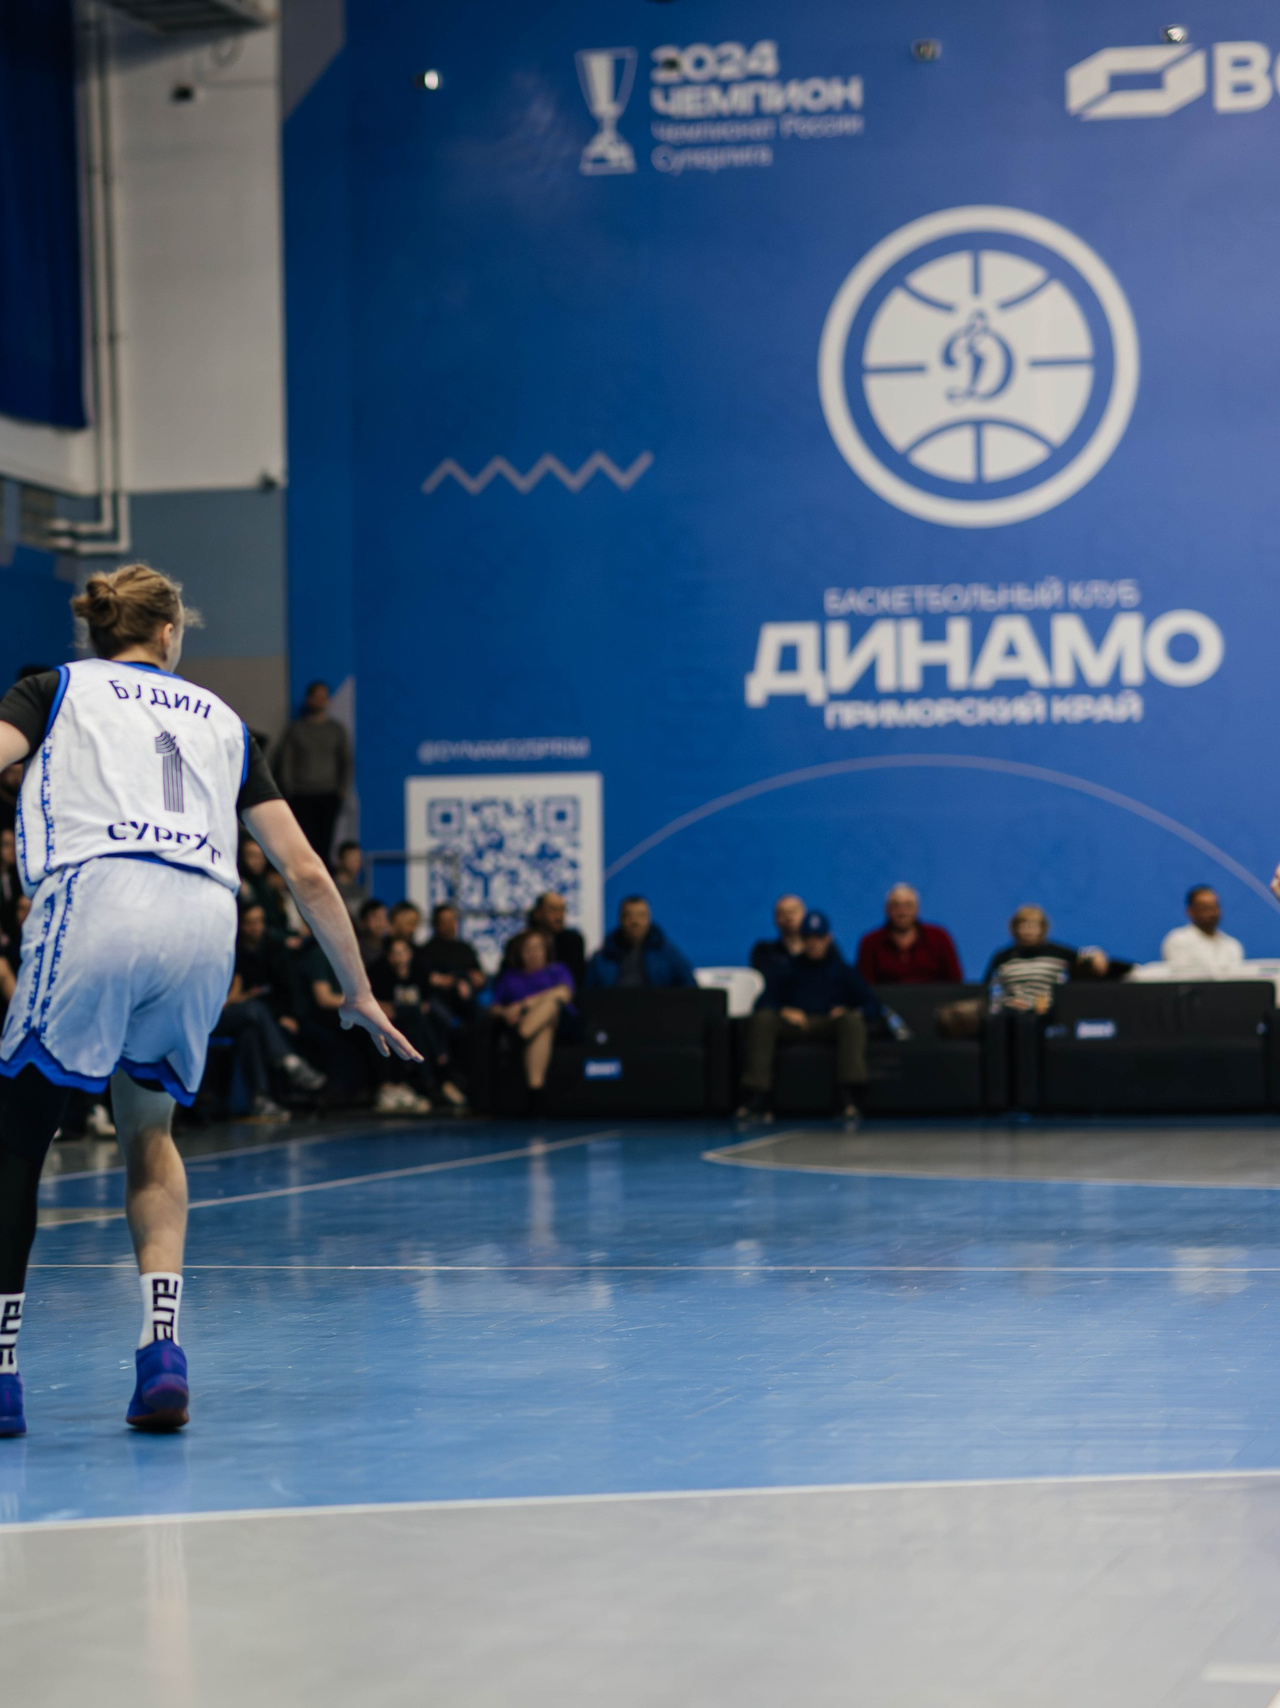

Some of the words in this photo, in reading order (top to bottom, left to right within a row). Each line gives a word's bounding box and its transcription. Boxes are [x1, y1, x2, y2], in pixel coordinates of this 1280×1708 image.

[650, 39, 780, 84] 2024
[1214, 41, 1280, 113] В
[650, 75, 864, 119] ЧЕМПИОН
[823, 576, 1063, 616] БАСКЕТБОЛЬНЫЙ
[1068, 578, 1141, 611] КЛУБ
[744, 608, 1225, 708] ДИНАМО
[824, 691, 1046, 729] ПРИМОРСКИЙ
[1050, 688, 1143, 725] КРАЙ
